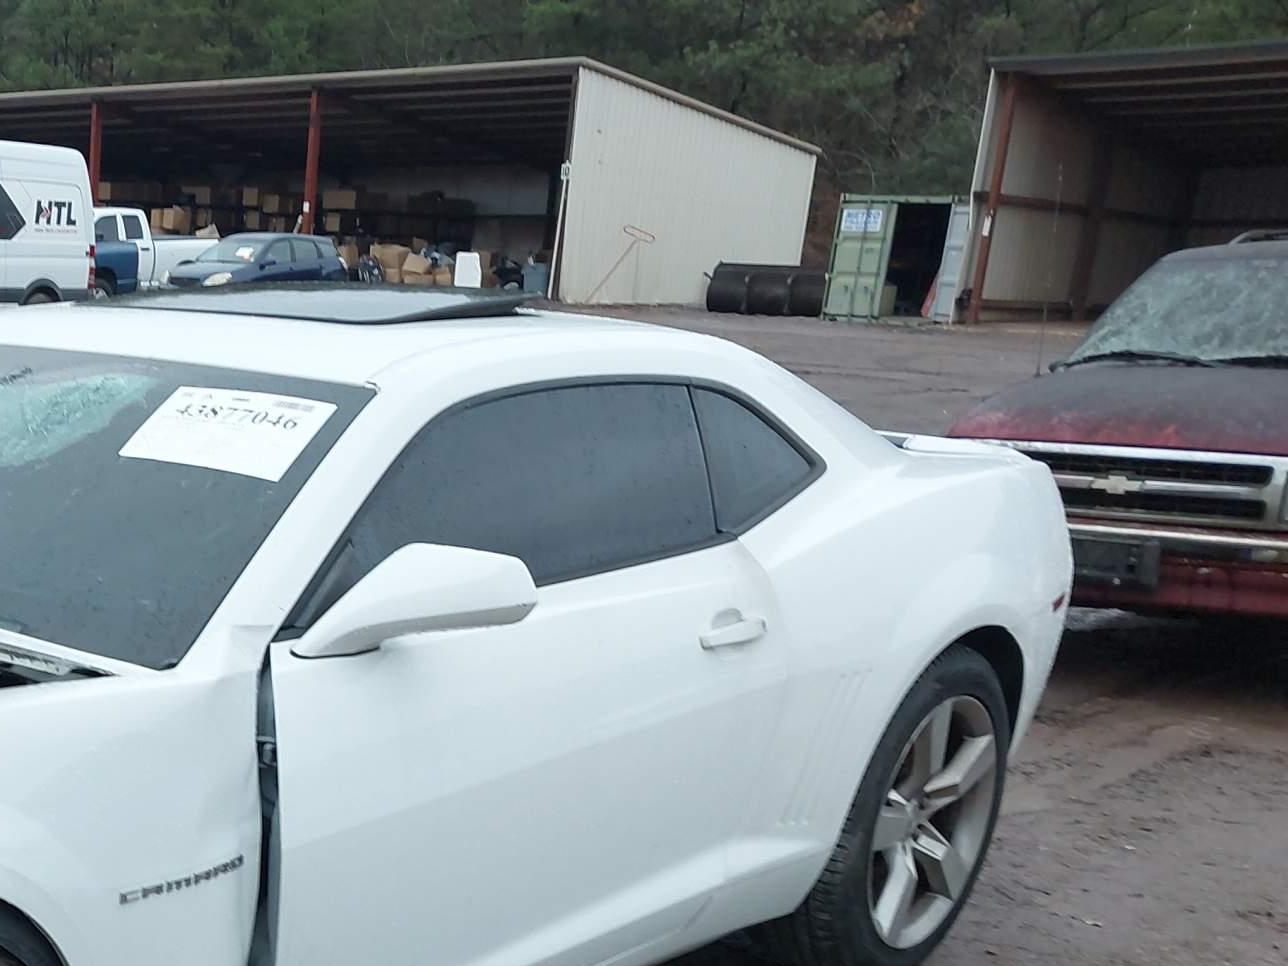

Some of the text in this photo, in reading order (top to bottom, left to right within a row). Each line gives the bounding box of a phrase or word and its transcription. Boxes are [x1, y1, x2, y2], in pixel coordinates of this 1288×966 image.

[35, 200, 77, 226] HTL
[176, 403, 298, 429] 43877046
[119, 854, 244, 905] CAMARO
